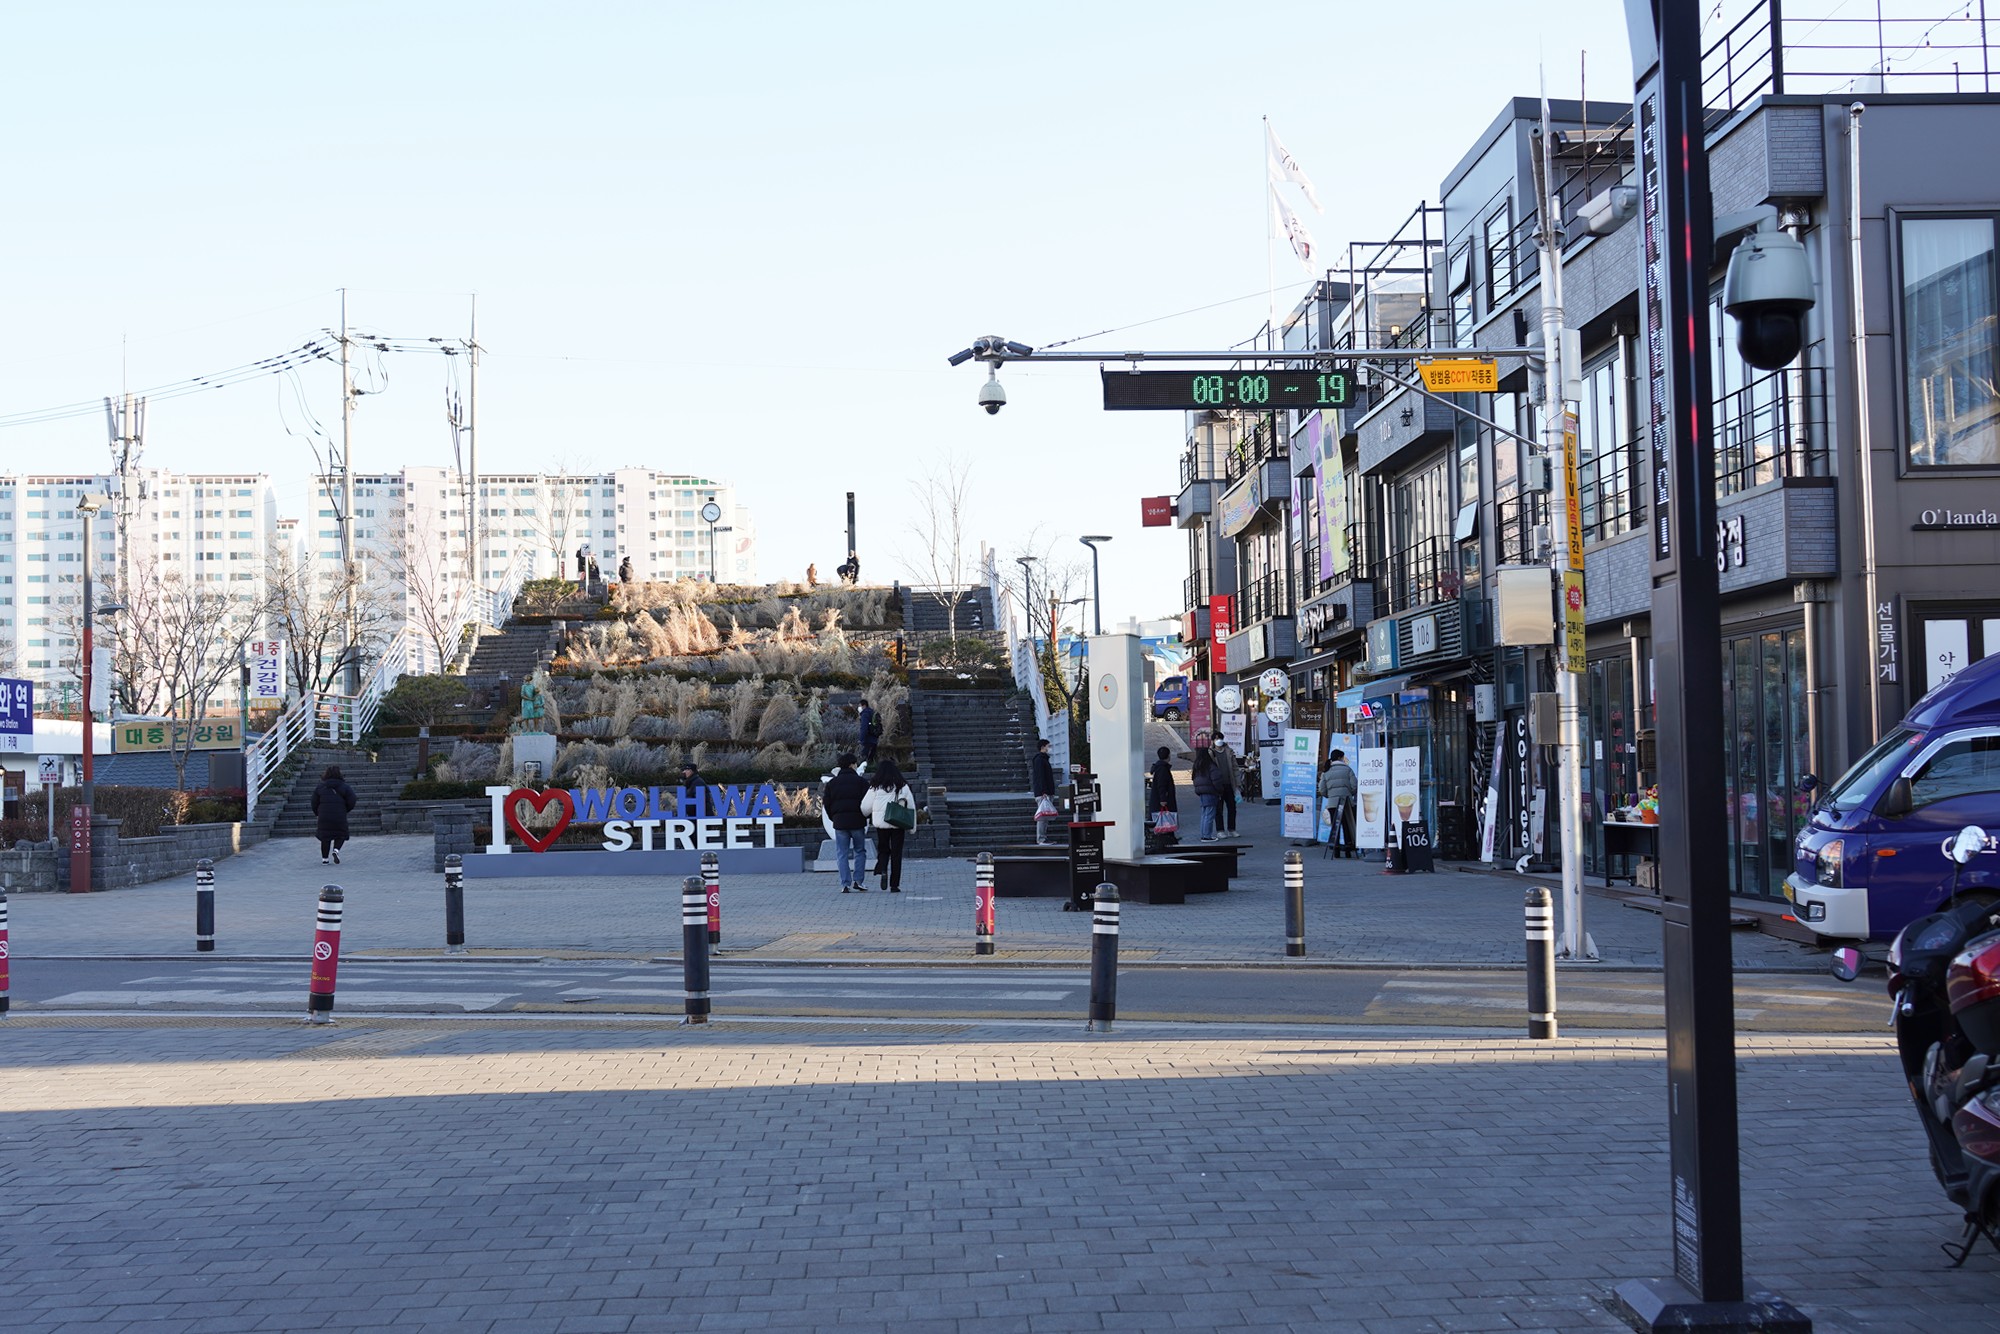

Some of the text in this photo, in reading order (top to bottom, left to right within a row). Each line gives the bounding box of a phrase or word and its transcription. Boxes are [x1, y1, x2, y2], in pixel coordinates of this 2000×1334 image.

[1193, 375, 1269, 404] 08:00
[1316, 375, 1345, 404] 19
[1379, 419, 1392, 443] 106
[1567, 436, 1575, 498] CCTV
[1570, 591, 1580, 604] 위험
[1416, 623, 1430, 647] 106
[1567, 621, 1584, 635] 교통사고
[251, 641, 281, 656] 대중
[1877, 602, 1898, 682] 선물가게
[256, 658, 280, 696] 건강원
[126, 725, 233, 745] 대중 건강원
[1297, 740, 1306, 748] N
[1371, 759, 1384, 768] 106
[1404, 758, 1417, 767] 106
[569, 784, 783, 823] WOLHWA
[485, 786, 513, 854] I
[601, 816, 784, 853] STREET
[1406, 834, 1428, 847] 106
